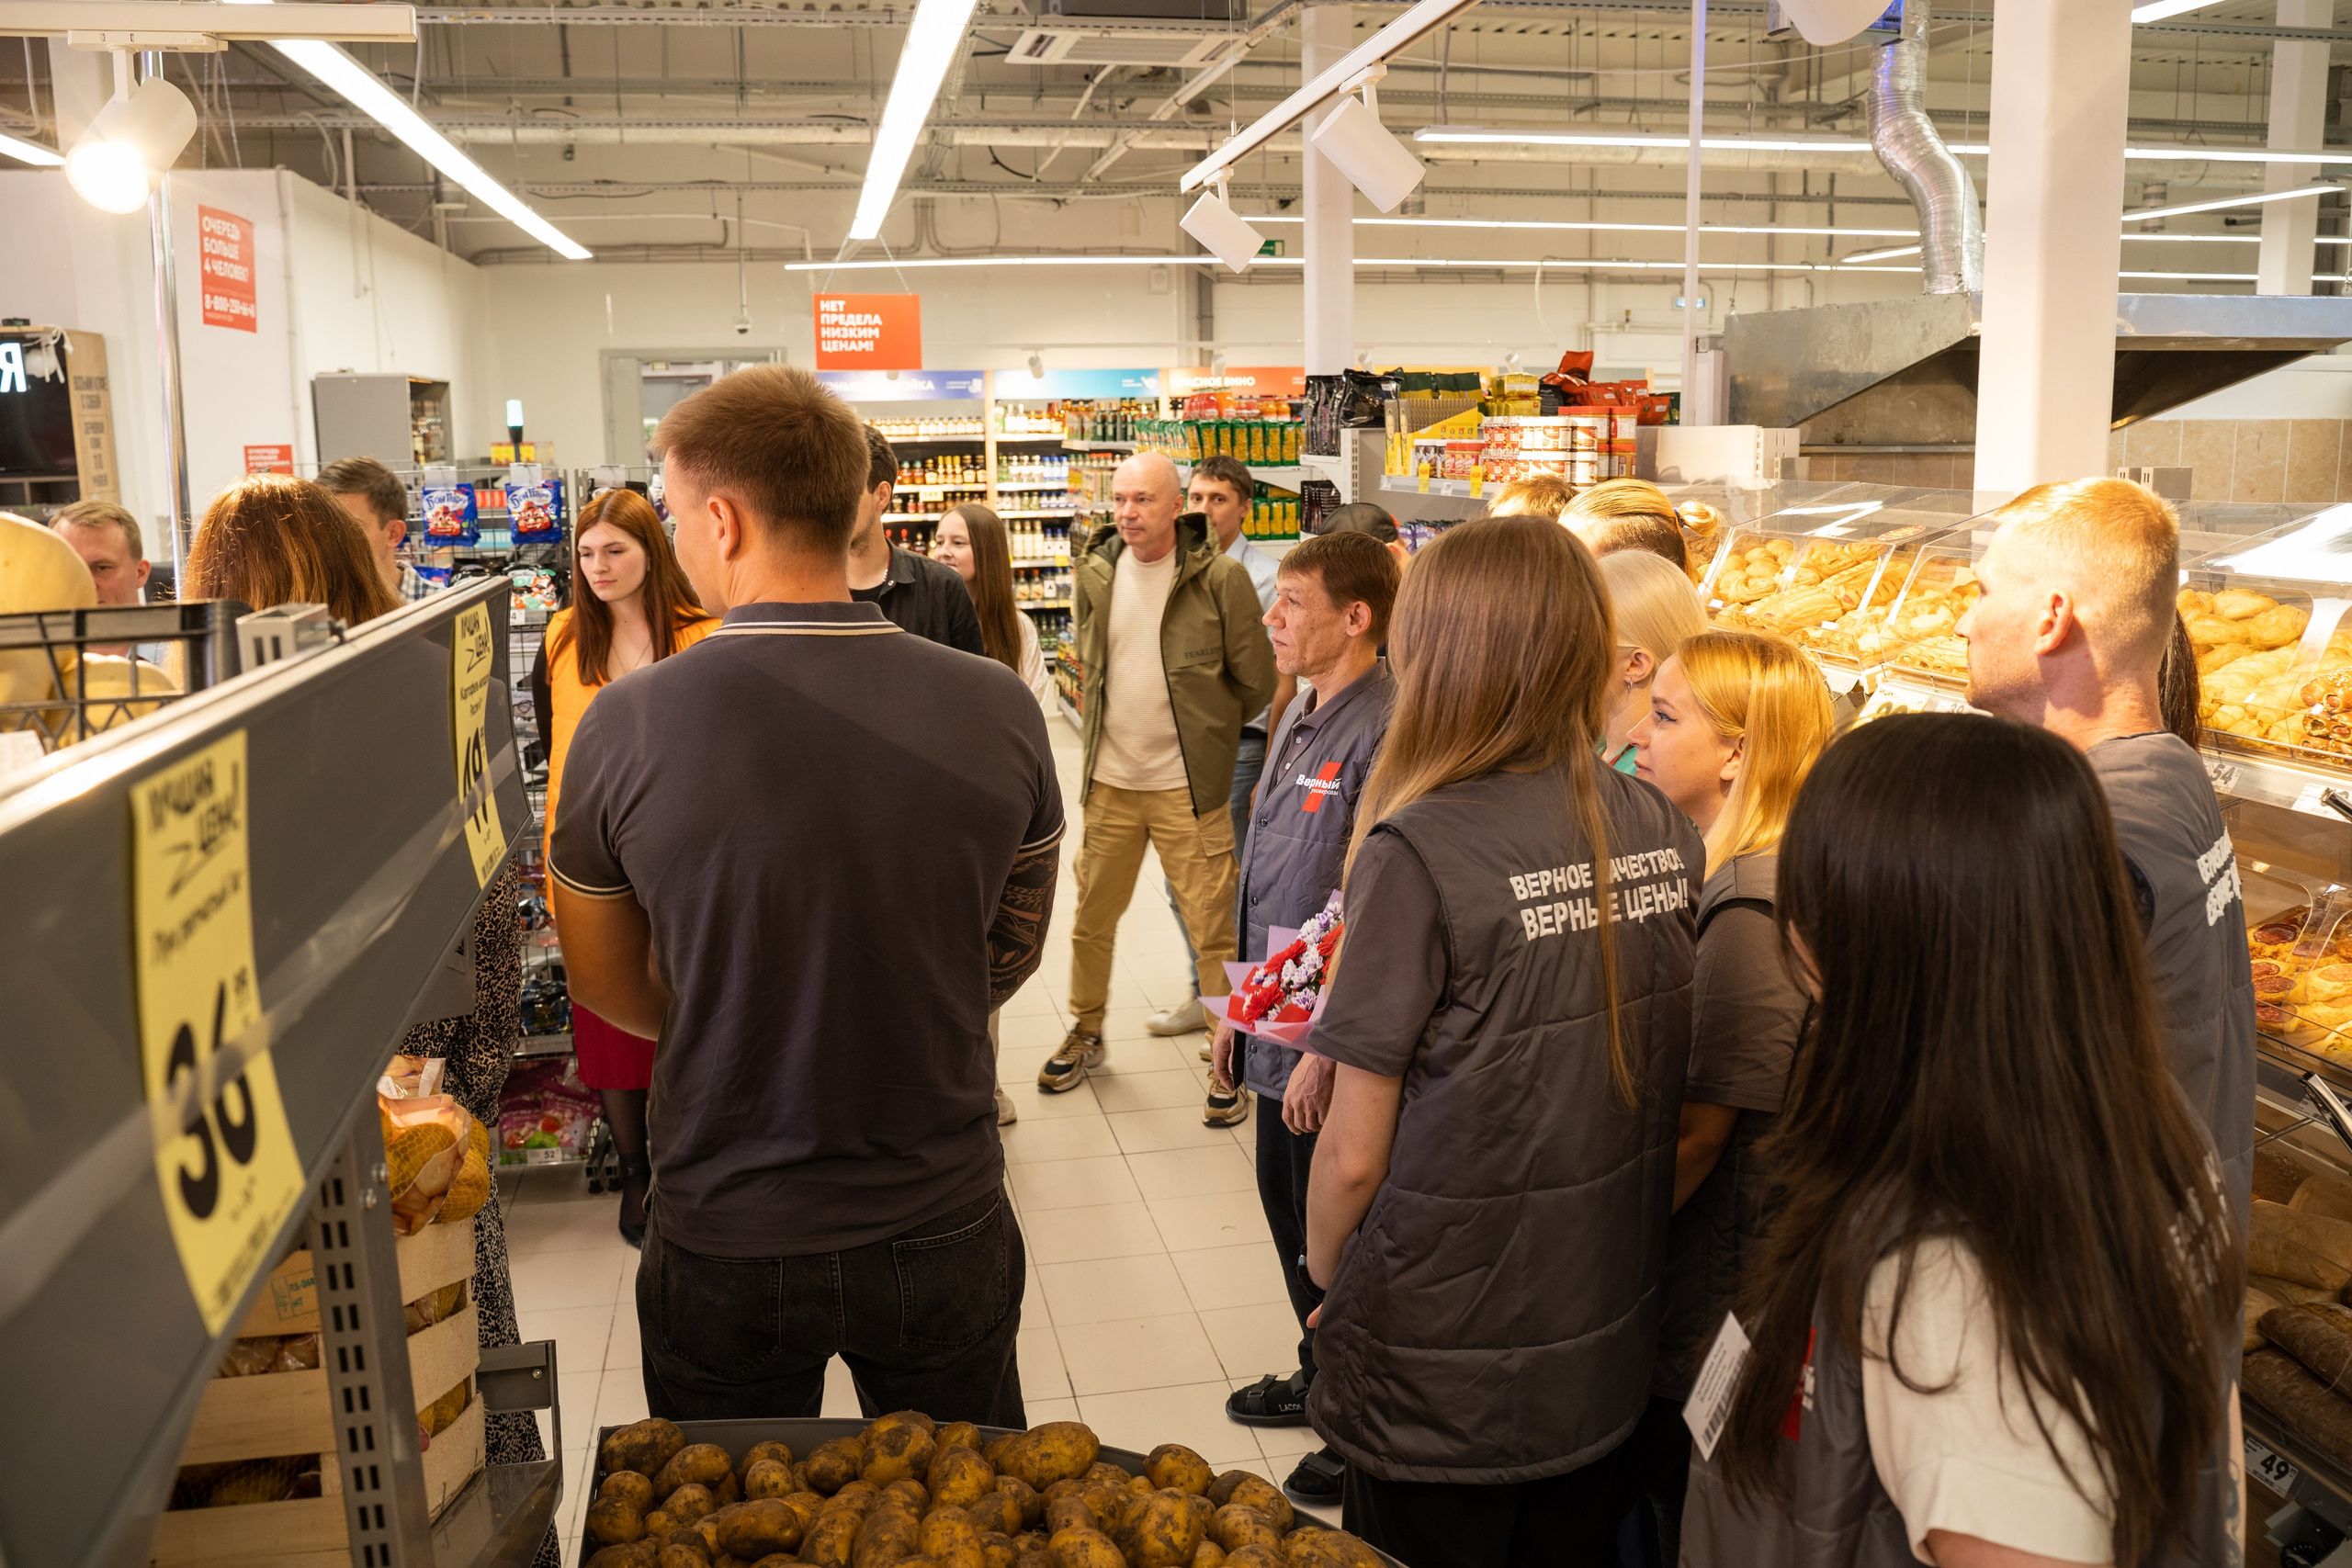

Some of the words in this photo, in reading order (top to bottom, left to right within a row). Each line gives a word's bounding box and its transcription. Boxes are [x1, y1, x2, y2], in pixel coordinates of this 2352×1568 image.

[820, 299, 846, 312] НЕТ
[820, 313, 883, 327] ПРЕДЕЛА
[821, 327, 880, 339] НИЗКИМ
[821, 340, 875, 353] ЦЕНАМ!
[1224, 376, 1256, 387] ВИНО
[1184, 646, 1224, 660] FEARLESS
[1295, 773, 1342, 790] Верный
[1510, 863, 1594, 901] ВЕРНОЕ
[1599, 848, 1686, 884] АЧЕСТВО!
[1624, 878, 1690, 923] ЦЕНЫ!
[164, 979, 258, 1223] 36
[2260, 1454, 2290, 1481] 49
